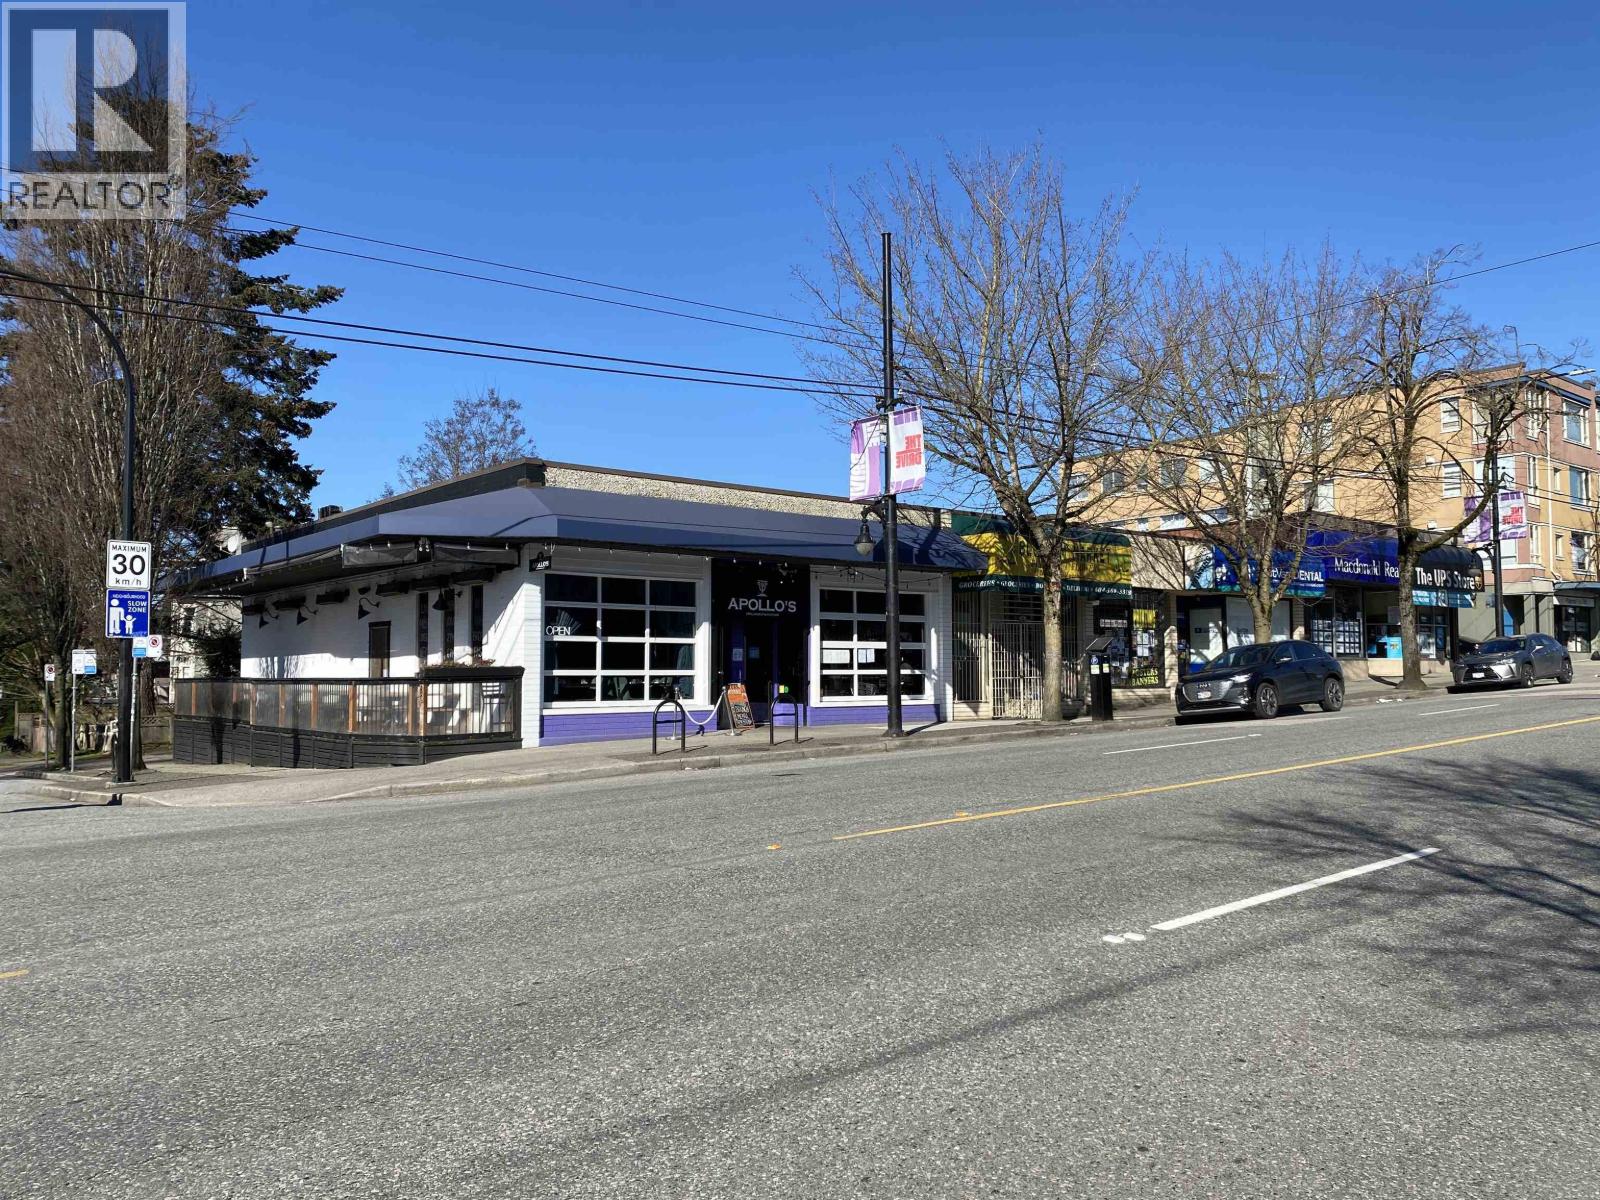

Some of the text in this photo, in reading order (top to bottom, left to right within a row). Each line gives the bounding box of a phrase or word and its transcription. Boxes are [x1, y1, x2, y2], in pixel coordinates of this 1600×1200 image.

[112, 545, 147, 553] MAXIMUM
[112, 554, 146, 575] 30
[1334, 557, 1400, 578] Macdonald Rea
[115, 578, 142, 586] km/h
[1415, 567, 1475, 590] The UPS Store
[727, 597, 797, 613] APOLLO'S
[546, 625, 571, 636] OPEN
